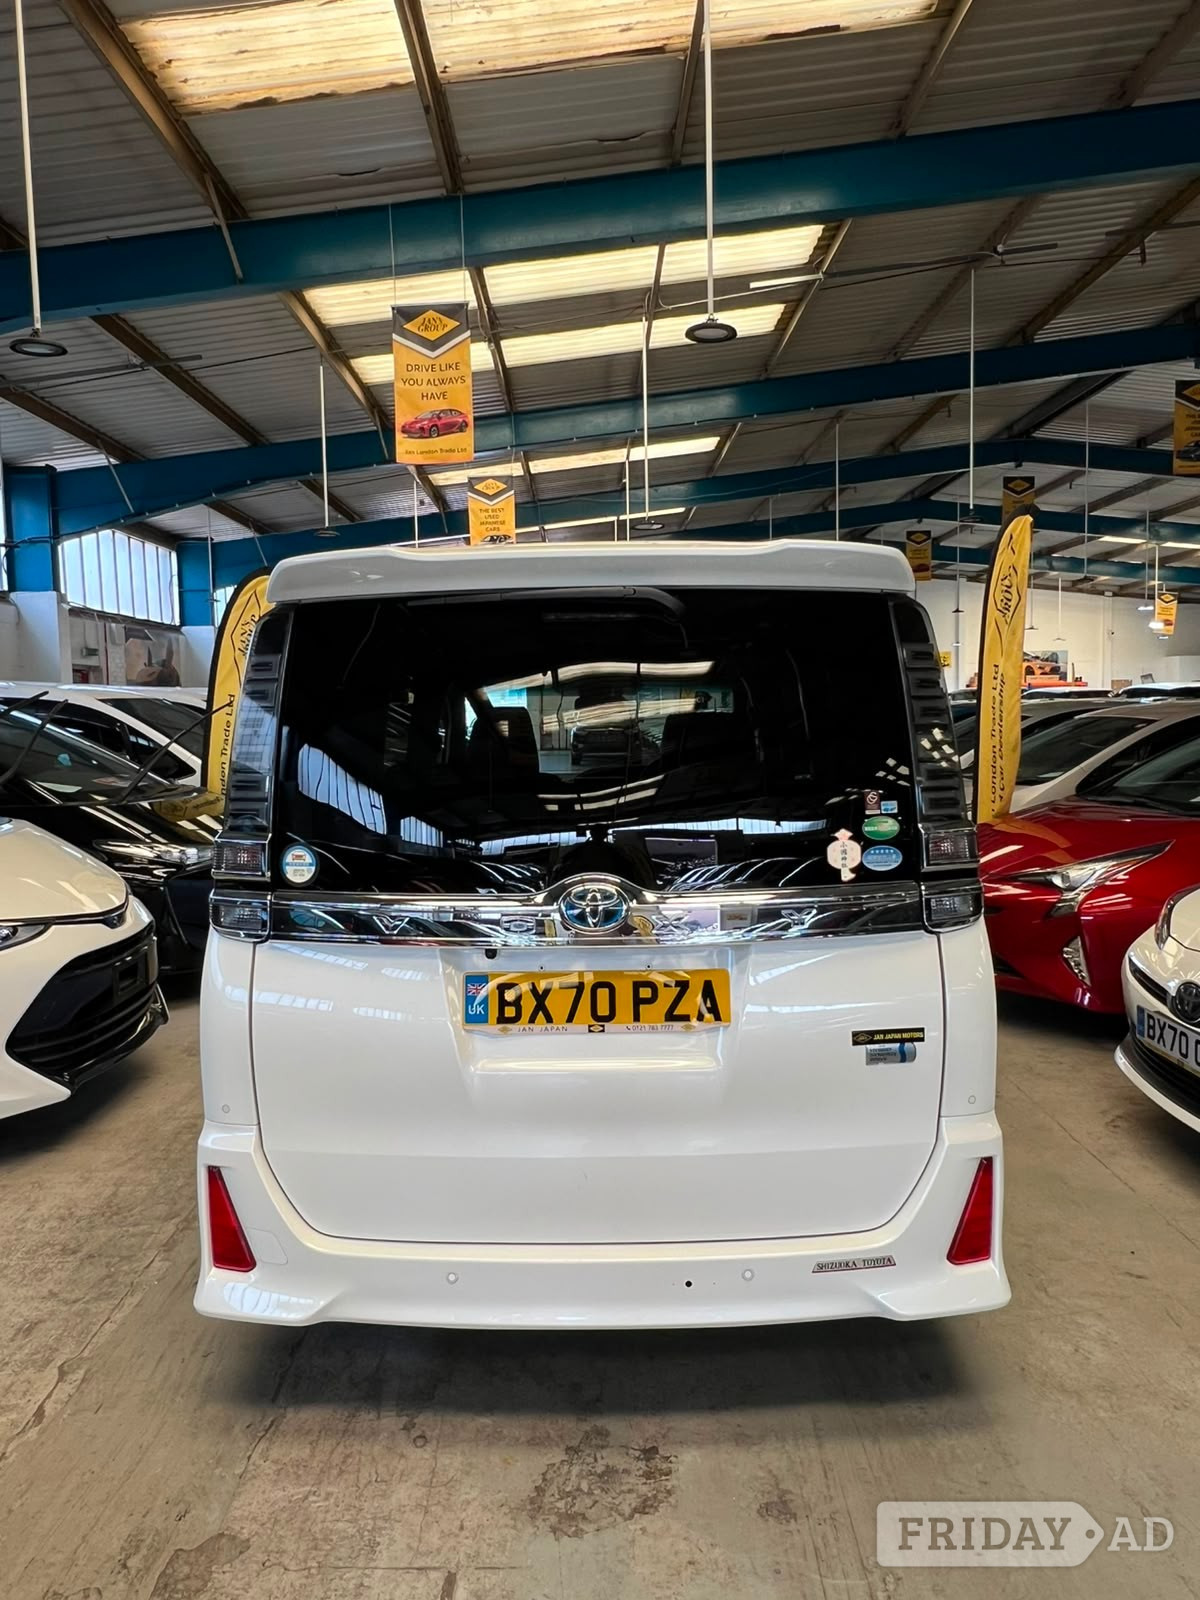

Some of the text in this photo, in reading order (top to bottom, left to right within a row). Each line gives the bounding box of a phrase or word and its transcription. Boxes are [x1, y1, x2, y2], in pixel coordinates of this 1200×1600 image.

[417, 323, 448, 332] GROUP
[406, 362, 461, 372] DRIVE LIKE
[401, 375, 466, 387] YOU ALWAYS
[421, 391, 448, 400] HAVE
[991, 664, 999, 691] Ltd
[220, 720, 232, 757] Trade
[219, 762, 227, 795] ndon
[496, 980, 723, 1024] BX70 PZA
[467, 1004, 485, 1015] UK
[1146, 1013, 1189, 1060] BX70
[816, 1257, 892, 1270] SHIZUOKA TOYOTA
